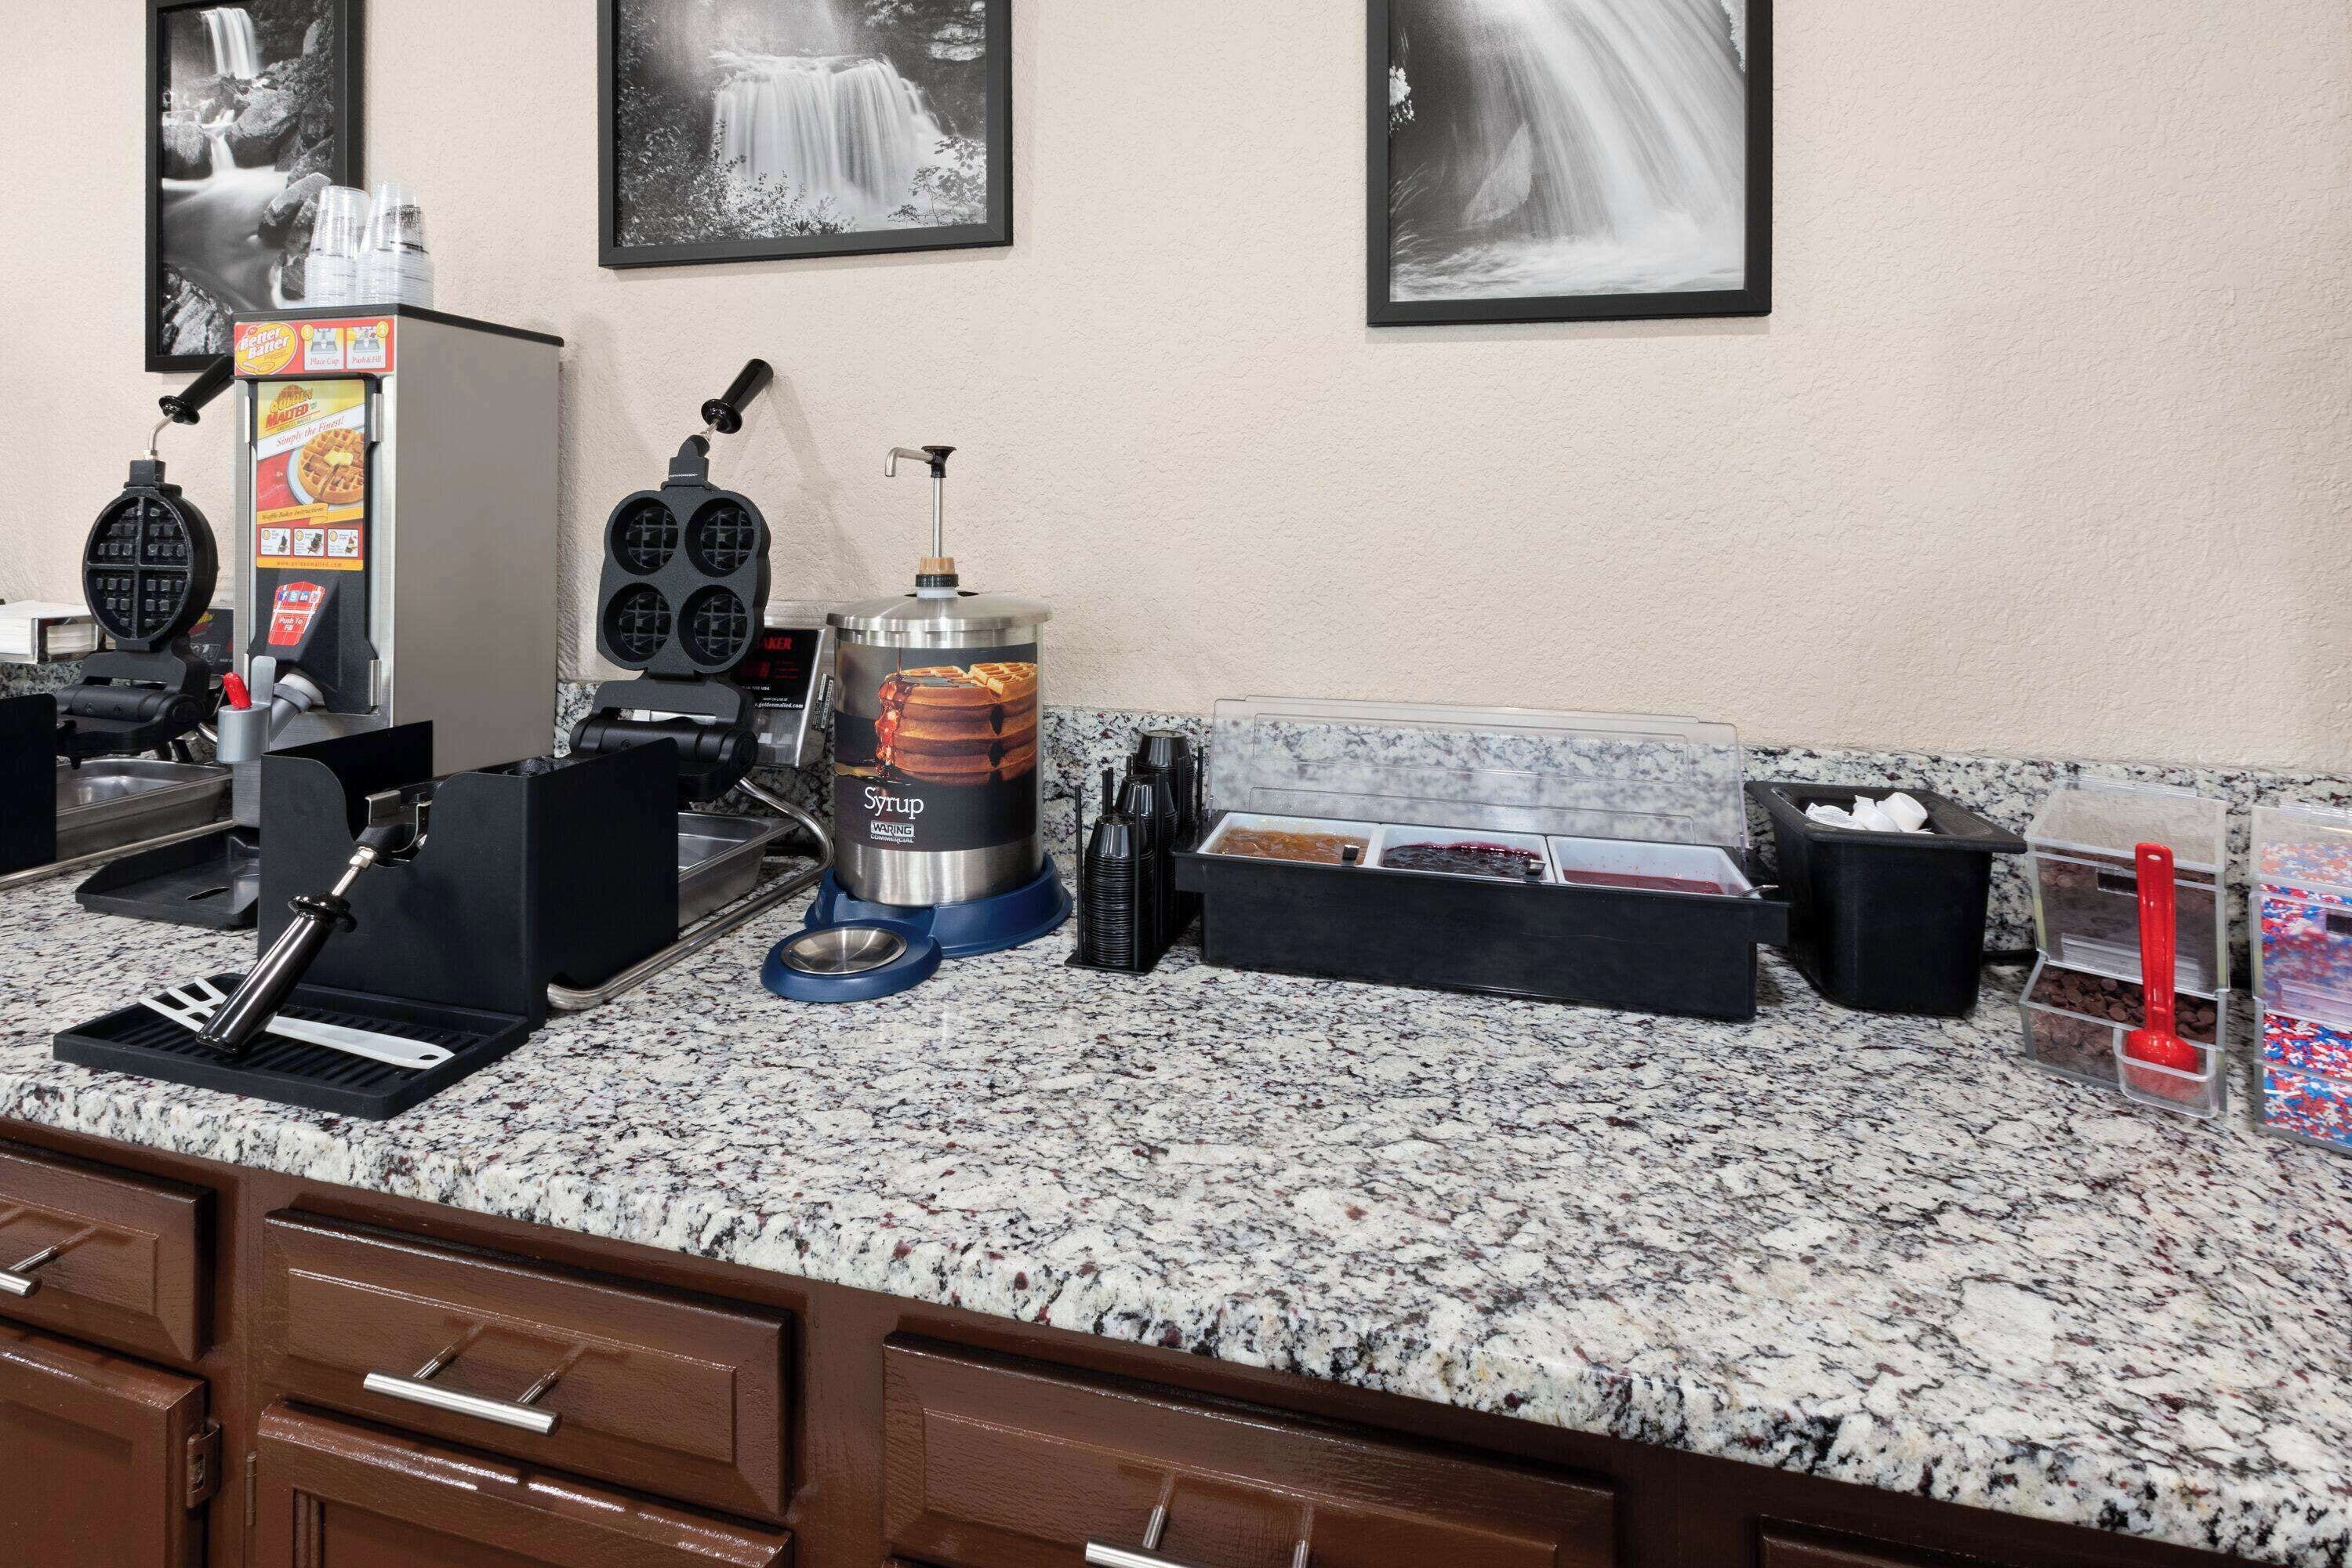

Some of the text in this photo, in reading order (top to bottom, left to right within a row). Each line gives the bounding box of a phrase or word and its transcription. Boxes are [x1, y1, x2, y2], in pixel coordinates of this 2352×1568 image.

[240, 327, 282, 351] Better
[249, 336, 289, 360] Batter
[327, 358, 339, 366] Cup
[266, 402, 309, 428] MALTED
[276, 415, 345, 446] Simply the Finest!
[864, 786, 924, 820] Syrup
[870, 834, 914, 844] COMMERCIAL
[873, 822, 912, 835] WARING
